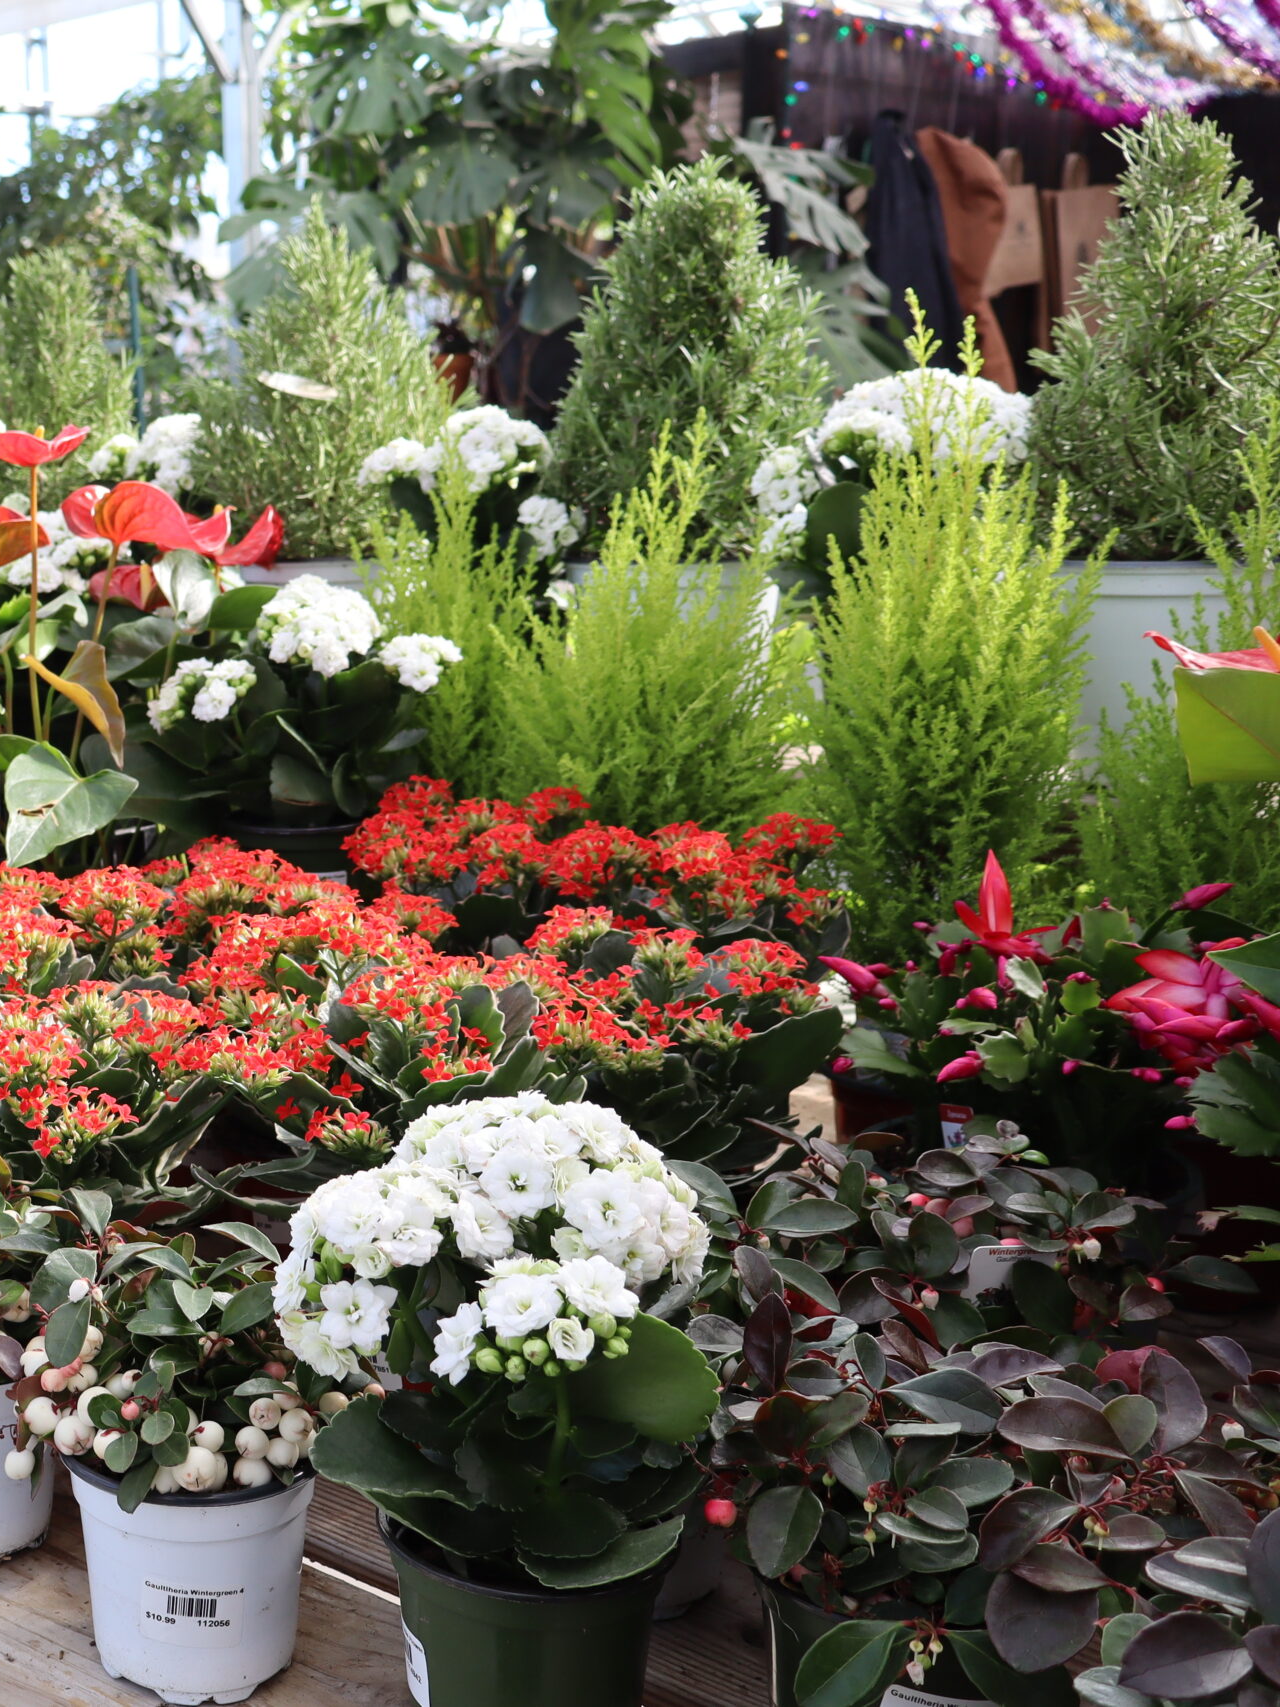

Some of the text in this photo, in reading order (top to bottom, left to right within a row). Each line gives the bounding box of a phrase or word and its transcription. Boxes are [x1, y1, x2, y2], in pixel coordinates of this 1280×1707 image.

[190, 1588, 238, 1598] Wintergreen
[145, 1611, 176, 1625] $10.99
[197, 1619, 231, 1628] 112056
